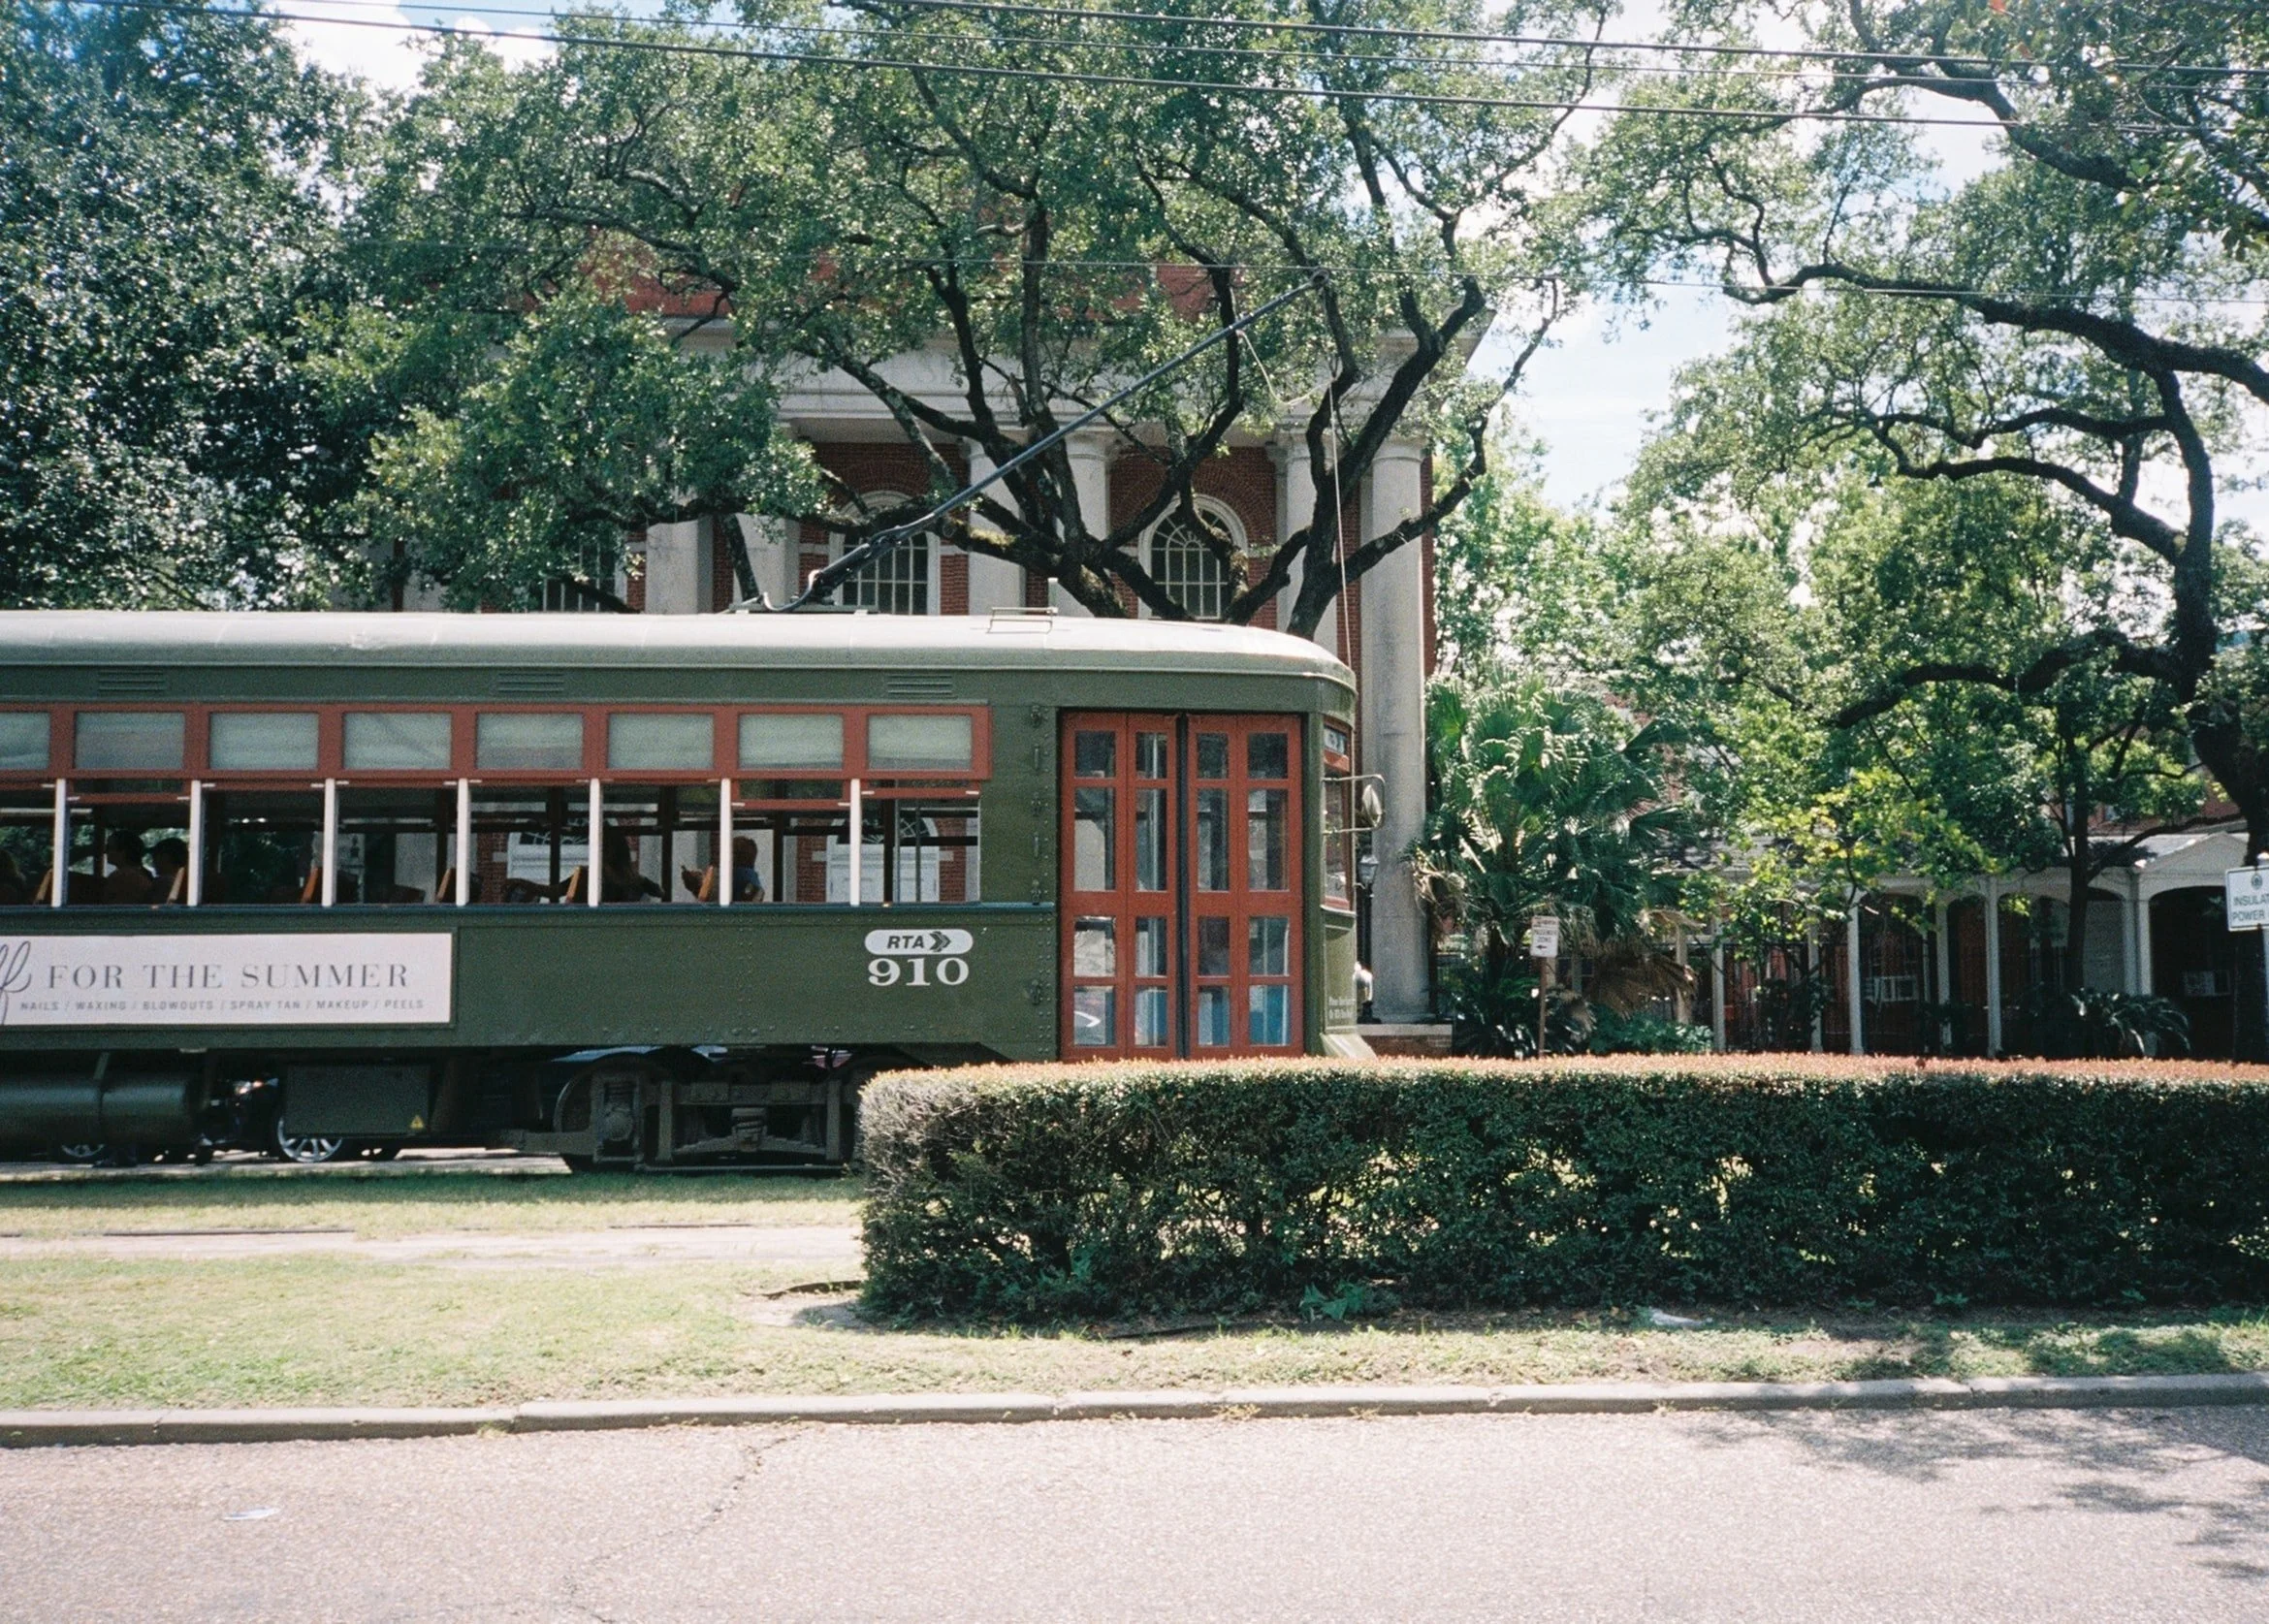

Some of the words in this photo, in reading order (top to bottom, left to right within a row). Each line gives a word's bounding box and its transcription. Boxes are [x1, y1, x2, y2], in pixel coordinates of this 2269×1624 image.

[2232, 909, 2265, 921] POWER
[887, 936, 924, 949] RTA
[49, 965, 122, 989] FOR
[143, 965, 222, 989] THE
[240, 964, 407, 988] SUMMER
[868, 957, 969, 986] 910
[20, 1001, 59, 1010] NAILS
[77, 1001, 126, 1009] WAXING
[143, 1001, 213, 1010] BLOWOUTS
[231, 1001, 271, 1010] SPRAY
[277, 1001, 301, 1009] TAN
[316, 1000, 368, 1009] MAKEUP
[384, 1000, 424, 1009] PEELS
